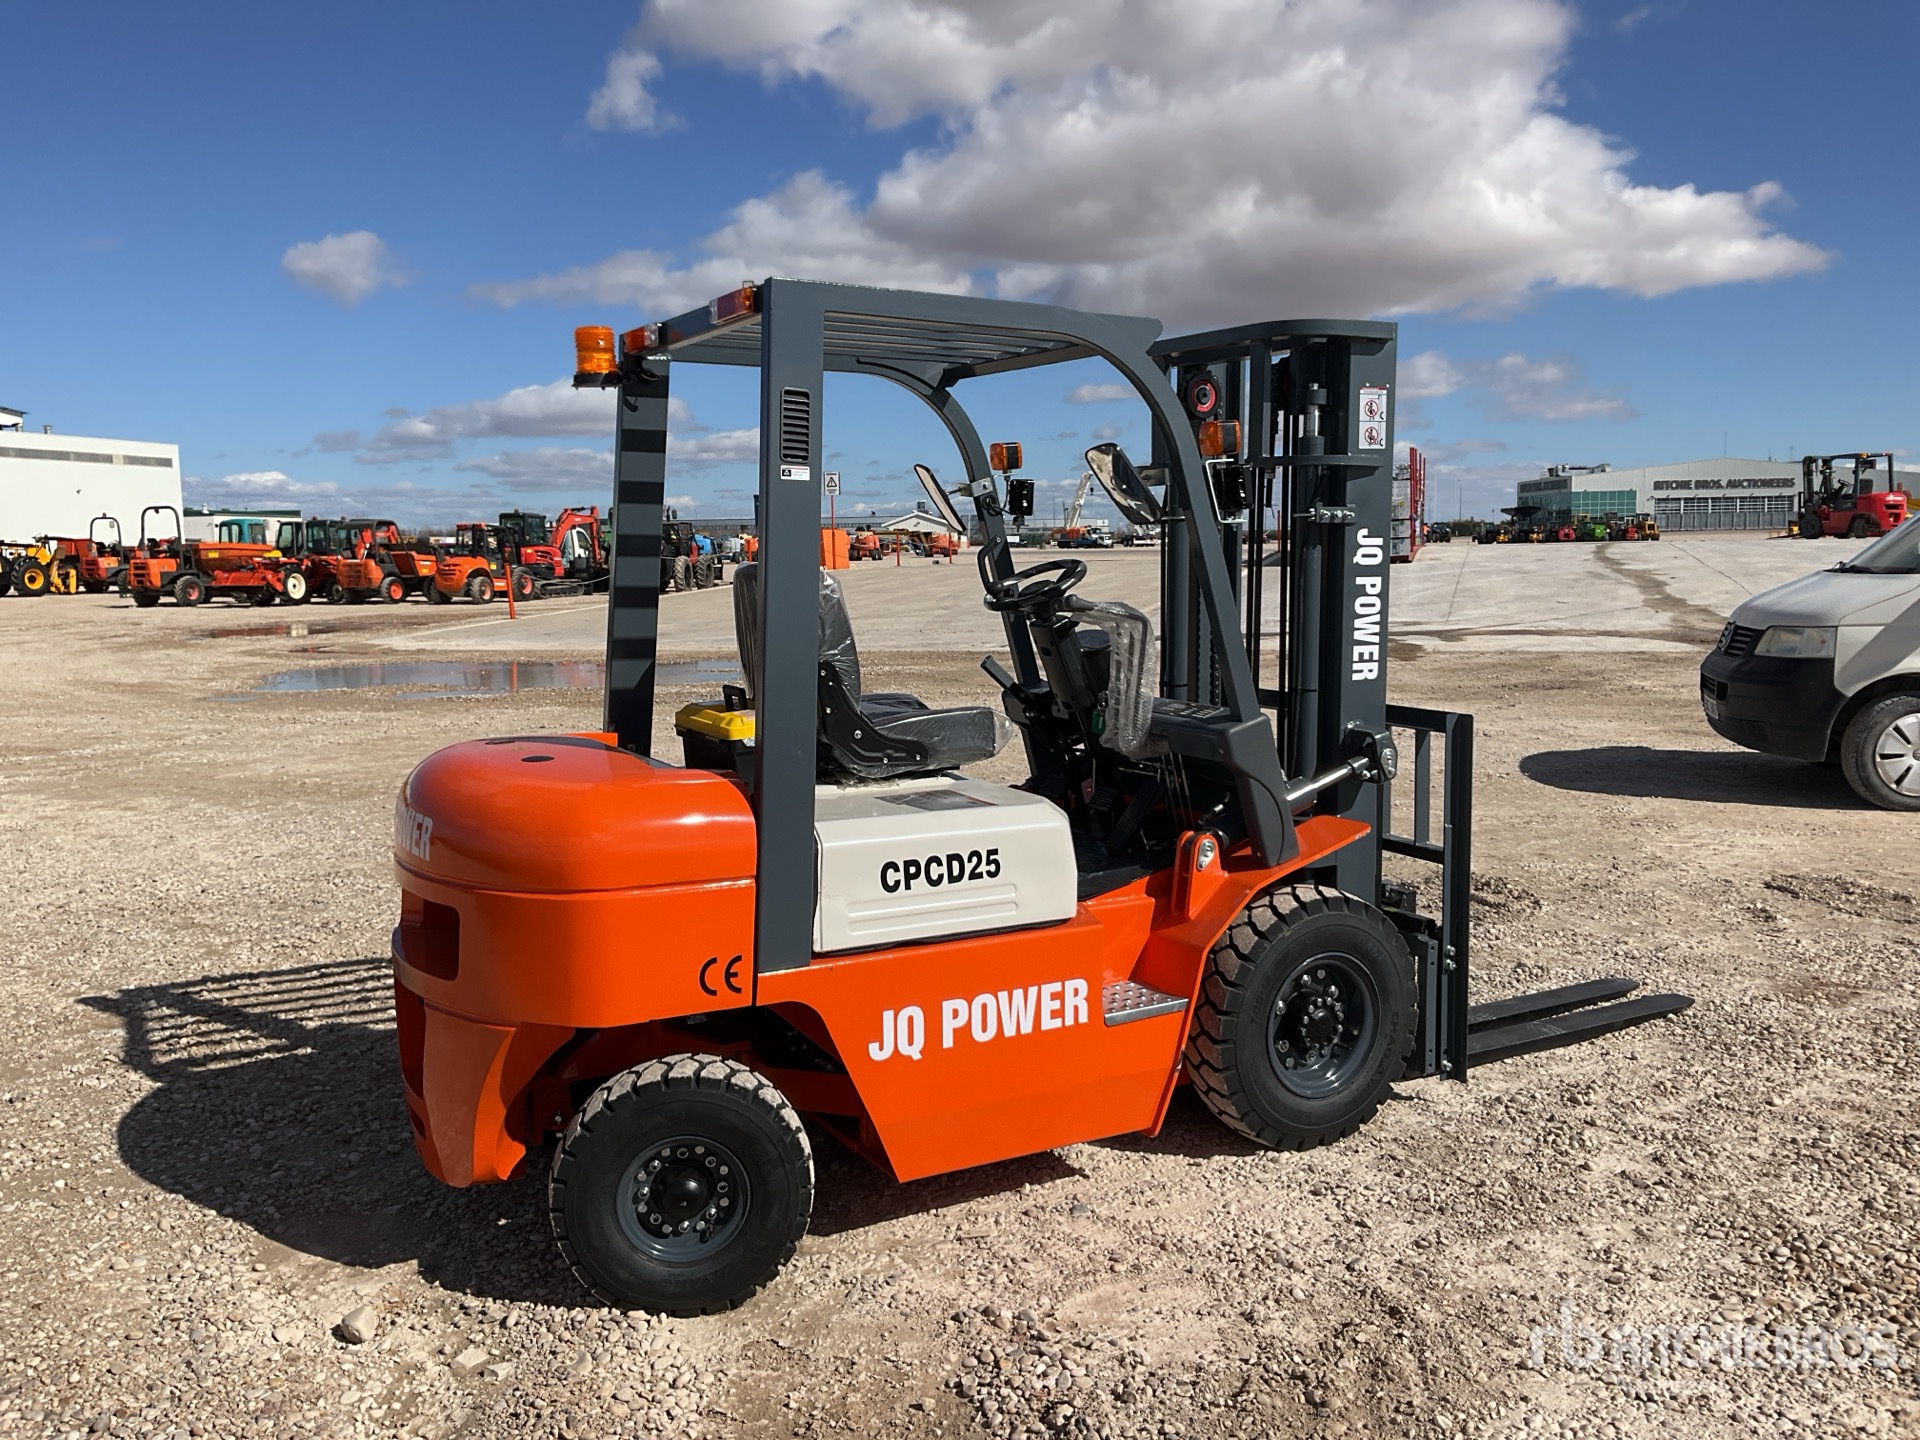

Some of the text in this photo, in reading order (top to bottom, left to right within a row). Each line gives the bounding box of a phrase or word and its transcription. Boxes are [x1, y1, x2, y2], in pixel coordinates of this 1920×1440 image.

[1653, 477, 1796, 490] RITCHIE BROS. AUCTIONEERS
[1351, 528, 1383, 681] JQ POWER
[880, 848, 1001, 893] CPCD25
[699, 954, 743, 997] CE
[868, 978, 1089, 1061] JQ POWER
